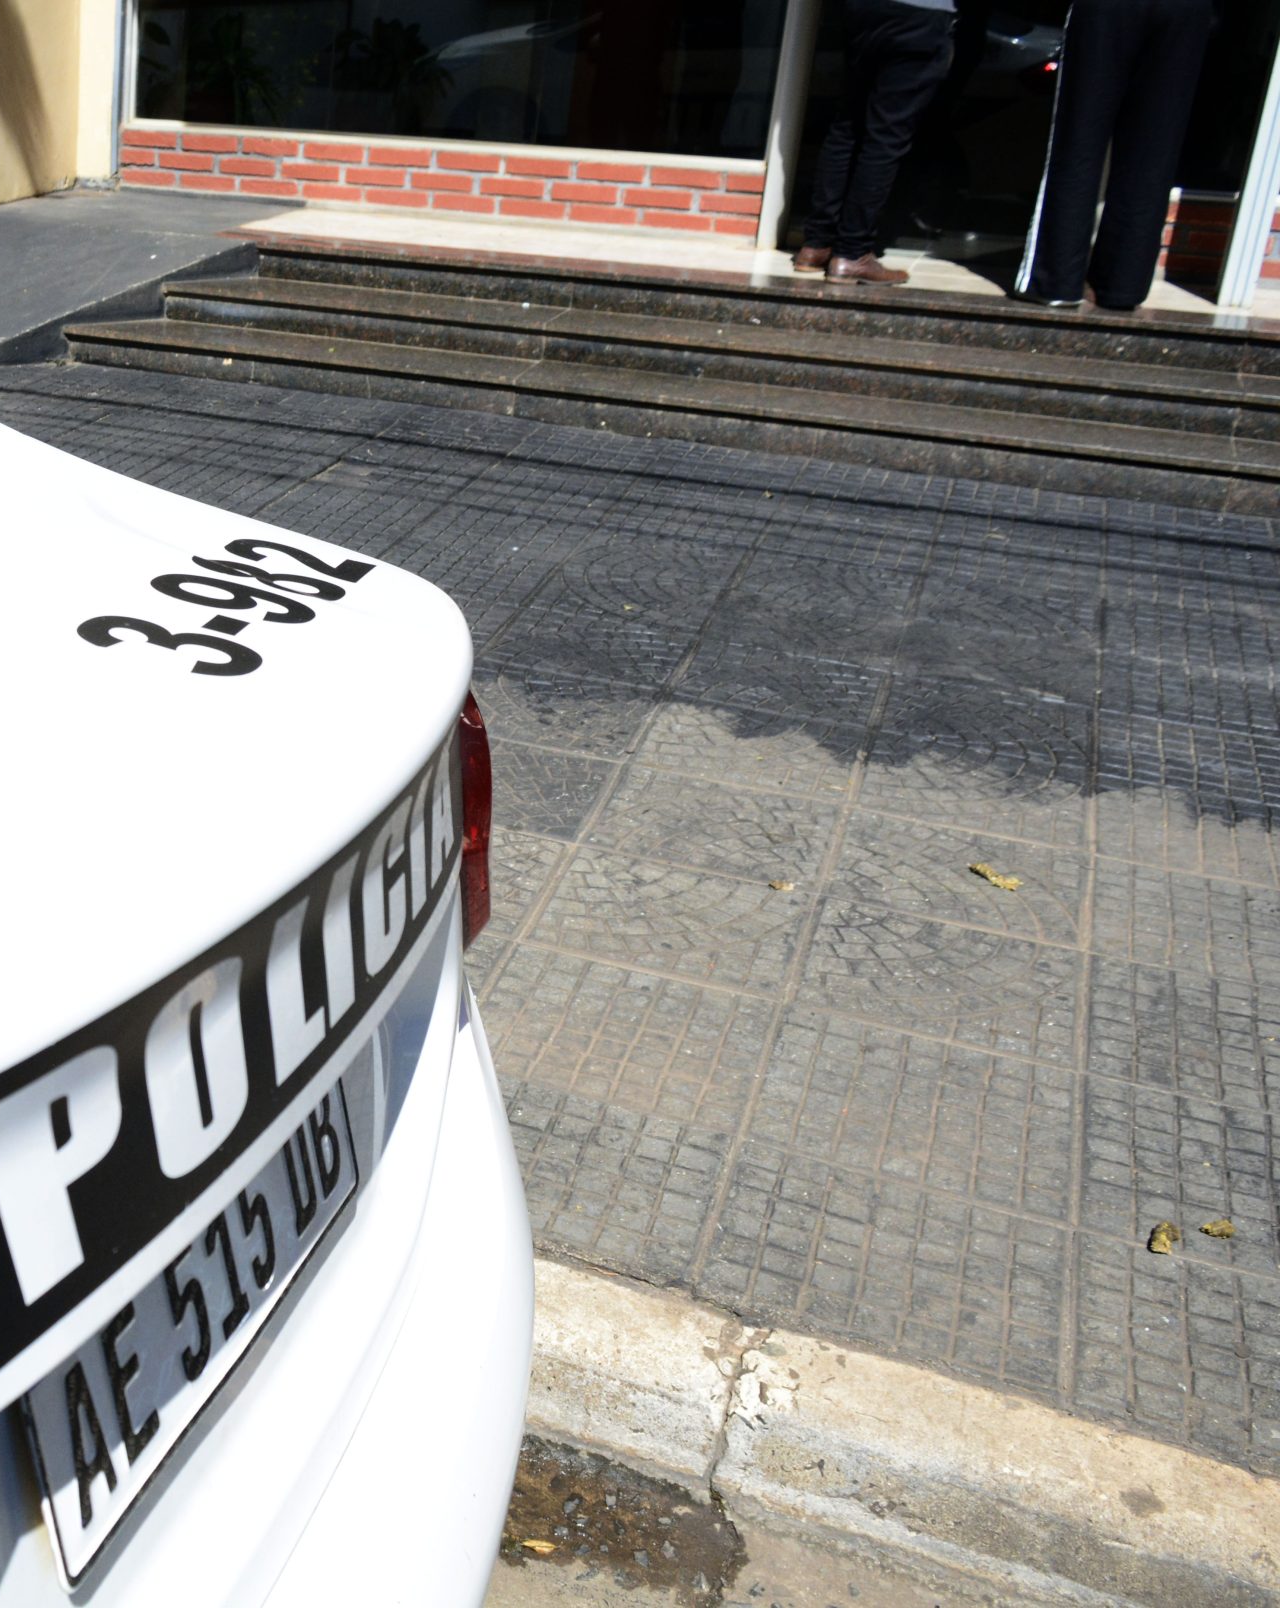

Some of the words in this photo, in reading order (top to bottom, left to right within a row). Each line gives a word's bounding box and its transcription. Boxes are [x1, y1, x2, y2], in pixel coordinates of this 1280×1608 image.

[77, 539, 376, 676] 3-982
[64, 1300, 160, 1529] AE
[163, 1189, 275, 1382] 515
